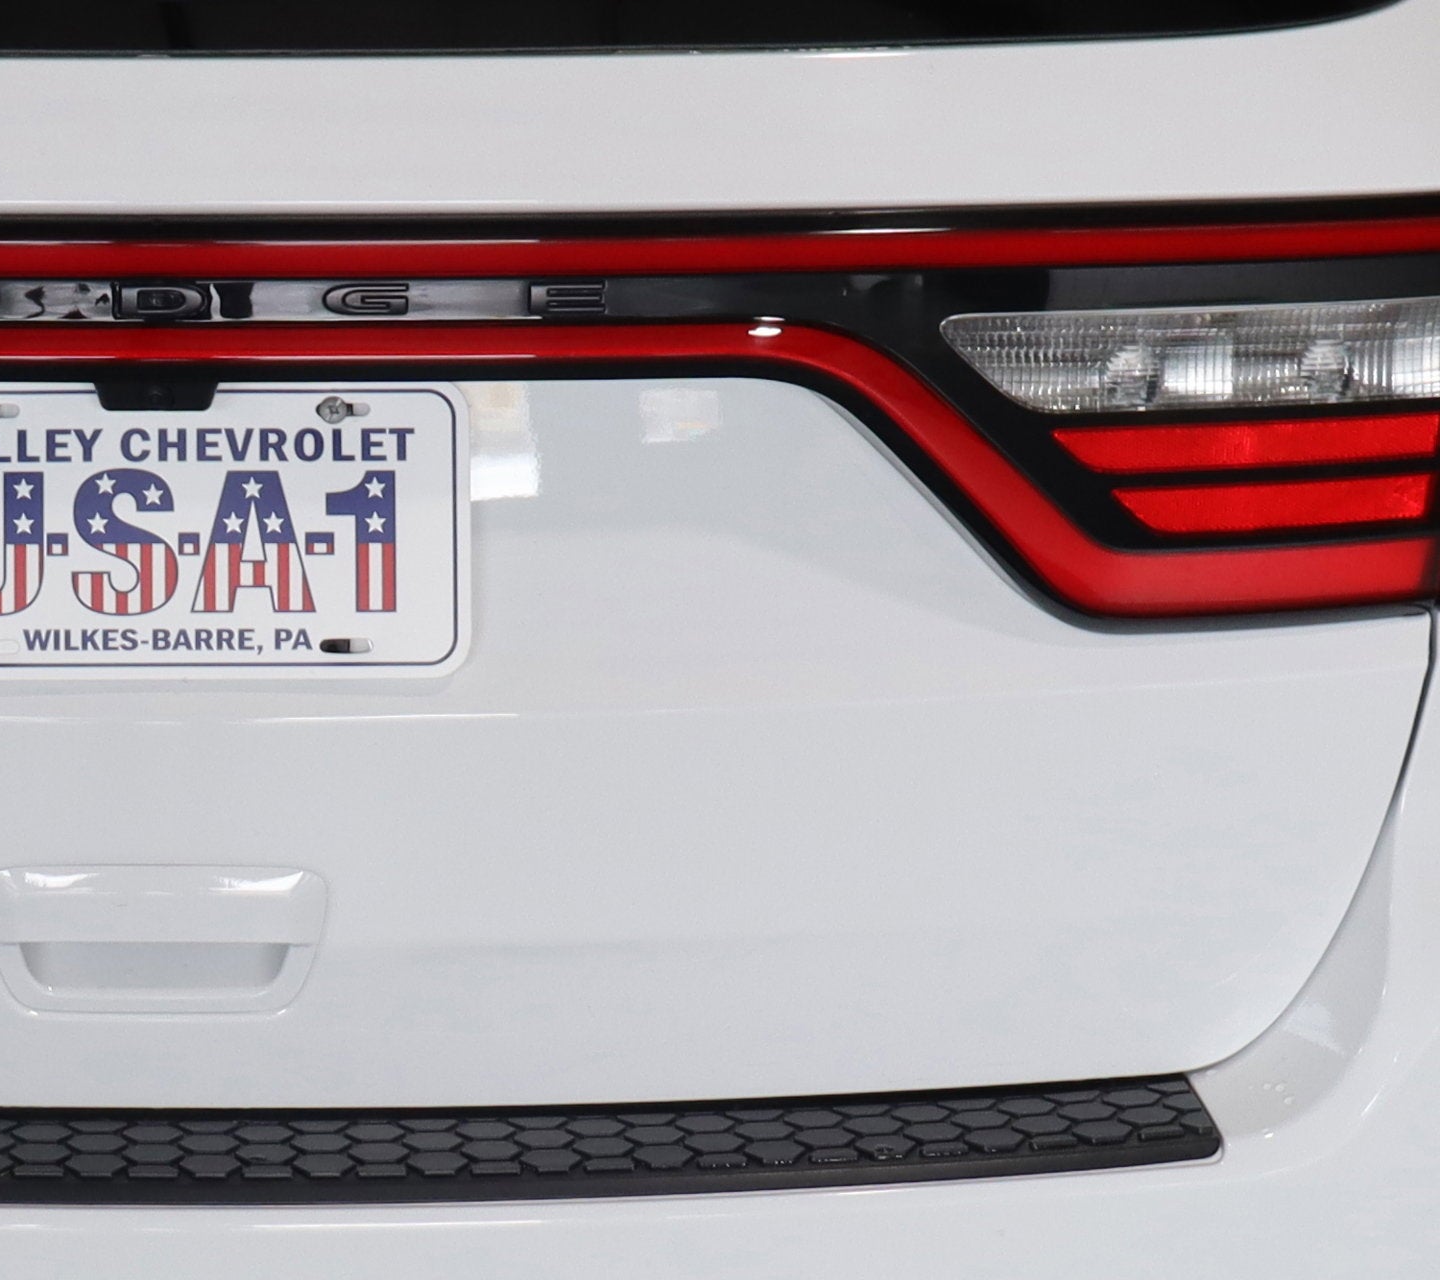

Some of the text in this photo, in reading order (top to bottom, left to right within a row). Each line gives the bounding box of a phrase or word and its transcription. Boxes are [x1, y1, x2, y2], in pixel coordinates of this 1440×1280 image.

[119, 427, 415, 463] CHEVROLET
[23, 628, 314, 655] WILKES-BARRE, PA
